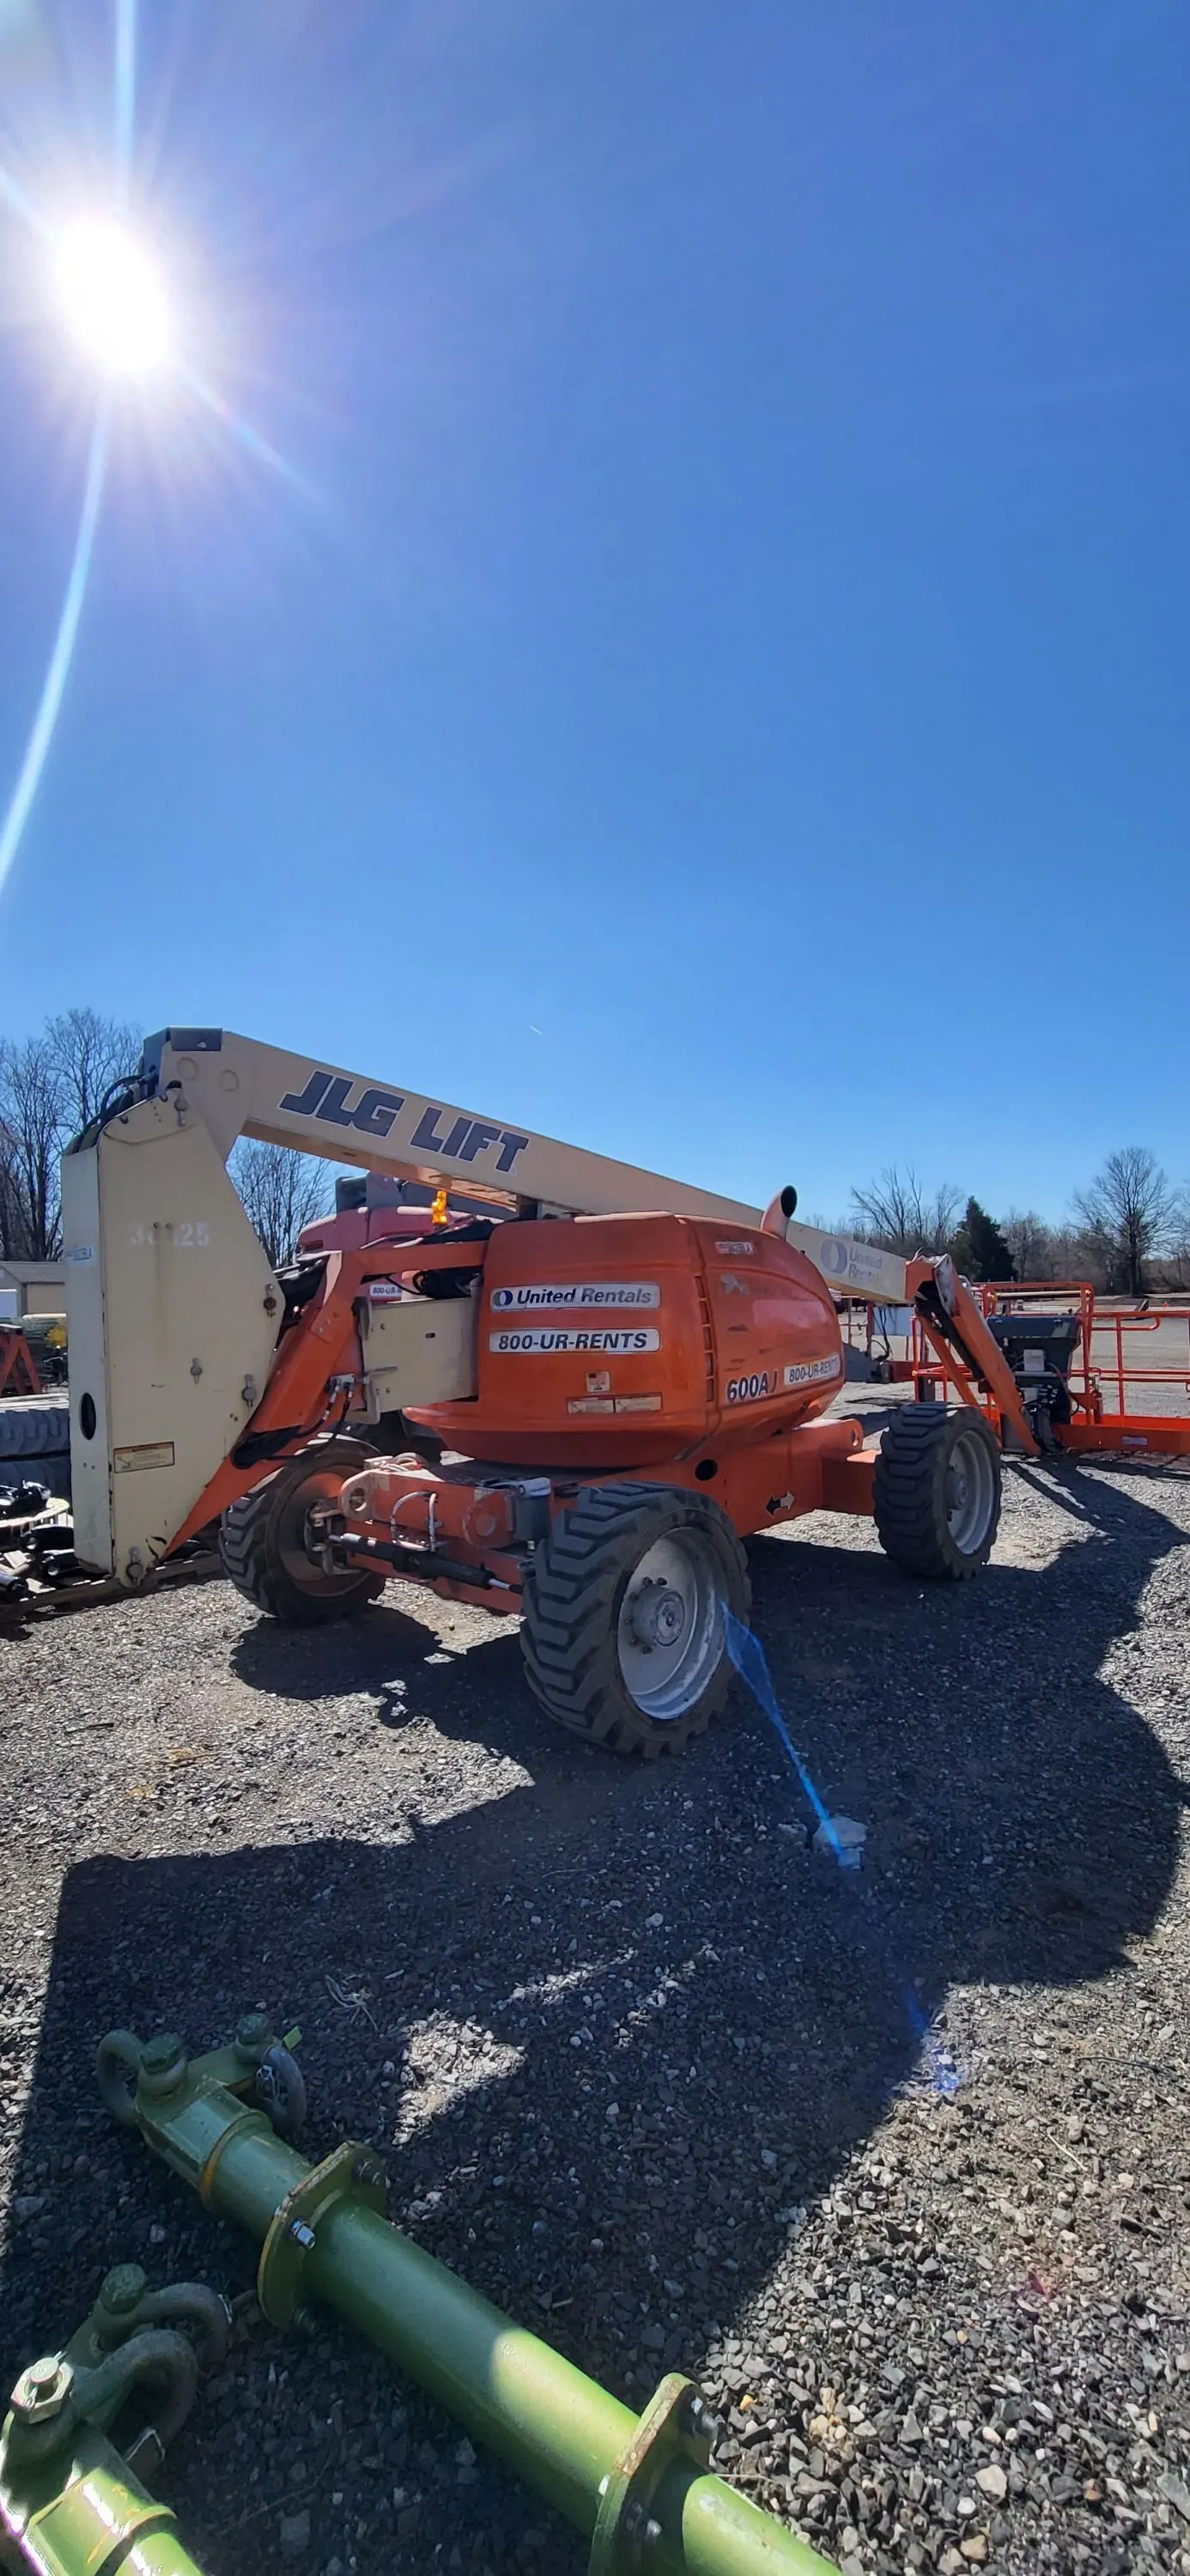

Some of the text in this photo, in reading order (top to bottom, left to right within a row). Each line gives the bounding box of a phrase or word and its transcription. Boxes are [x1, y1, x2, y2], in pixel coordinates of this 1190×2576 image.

[277, 1070, 530, 1173] JLG LIFT
[517, 1288, 653, 1304] United Rentals
[498, 1332, 648, 1351] 800-UR-RENTS
